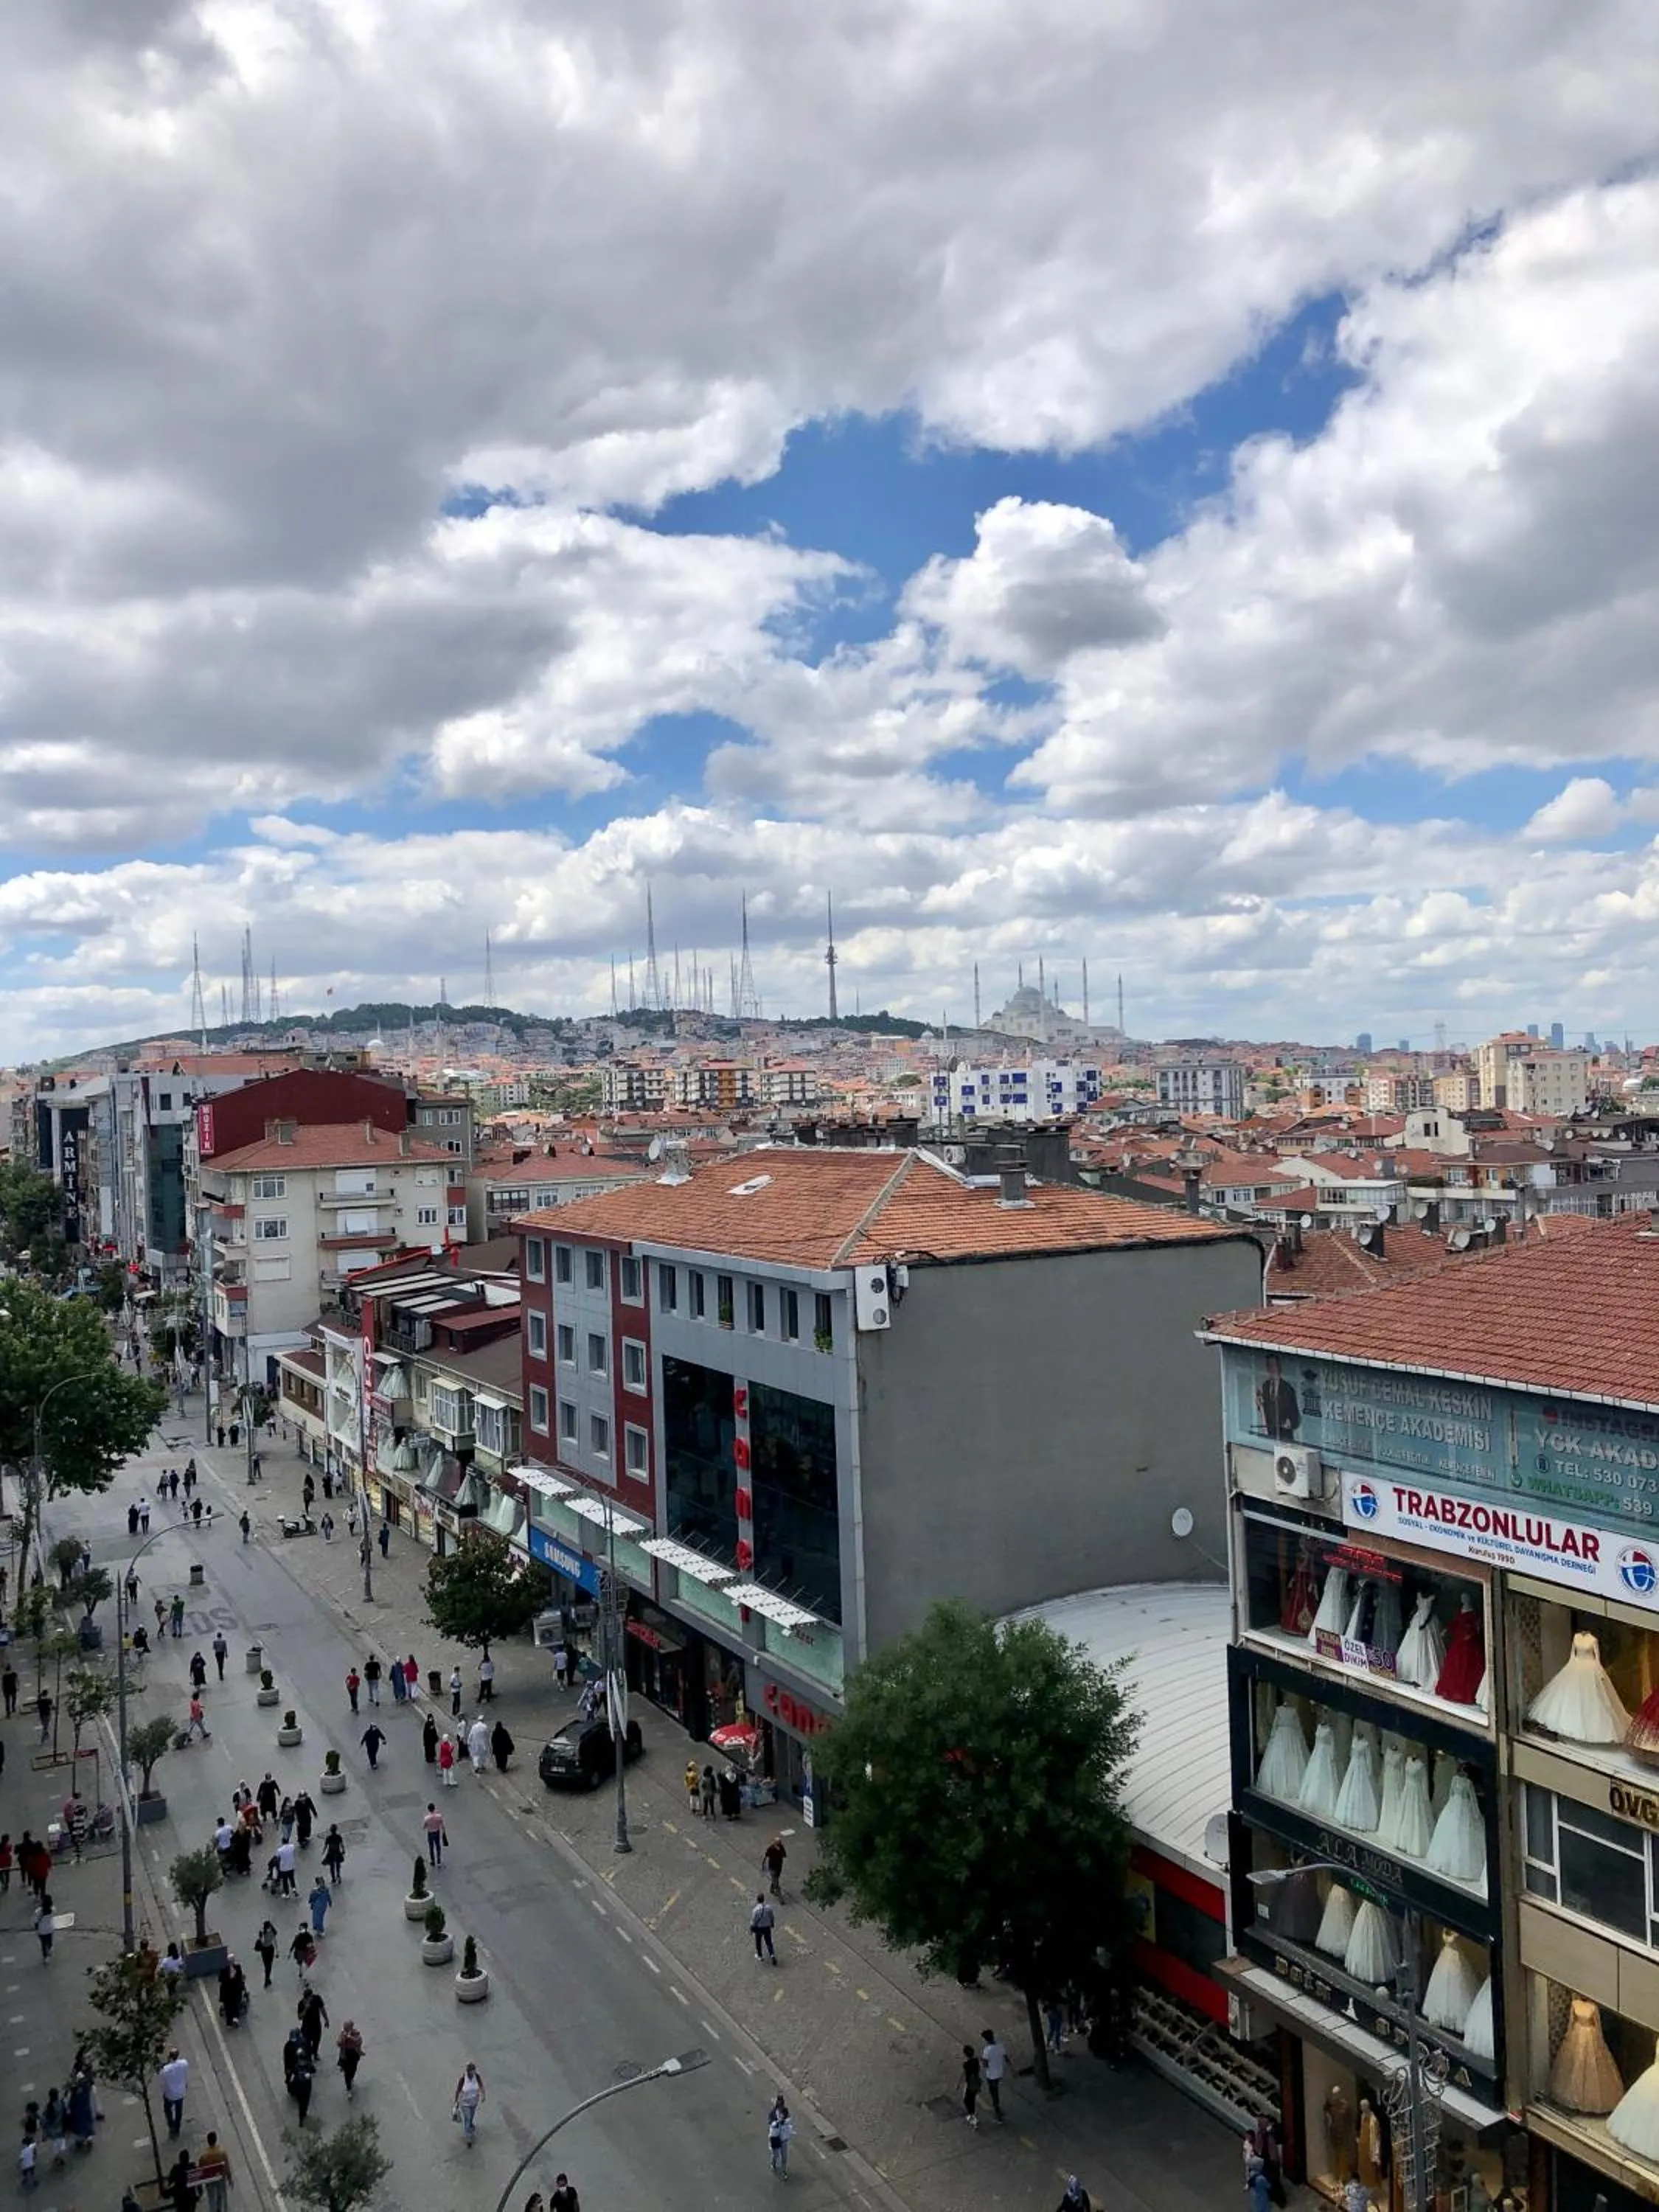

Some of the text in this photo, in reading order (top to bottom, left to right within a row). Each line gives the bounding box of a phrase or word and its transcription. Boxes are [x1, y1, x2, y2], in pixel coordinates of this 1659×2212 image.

[1326, 1401, 1397, 1435] KEMENÇE
[1400, 1415, 1492, 1453] AKADEMİSİ
[1593, 1468, 1622, 1486] 530
[1393, 1487, 1600, 1562] TRABZONLULAR
[1622, 1497, 1654, 1516] 539
[543, 1542, 582, 1579] SAMSUNG
[1397, 1516, 1424, 1530] SOSYAL
[1560, 1556, 1596, 1576] DERNEĞİ
[1344, 1638, 1365, 1656] ÖZEL
